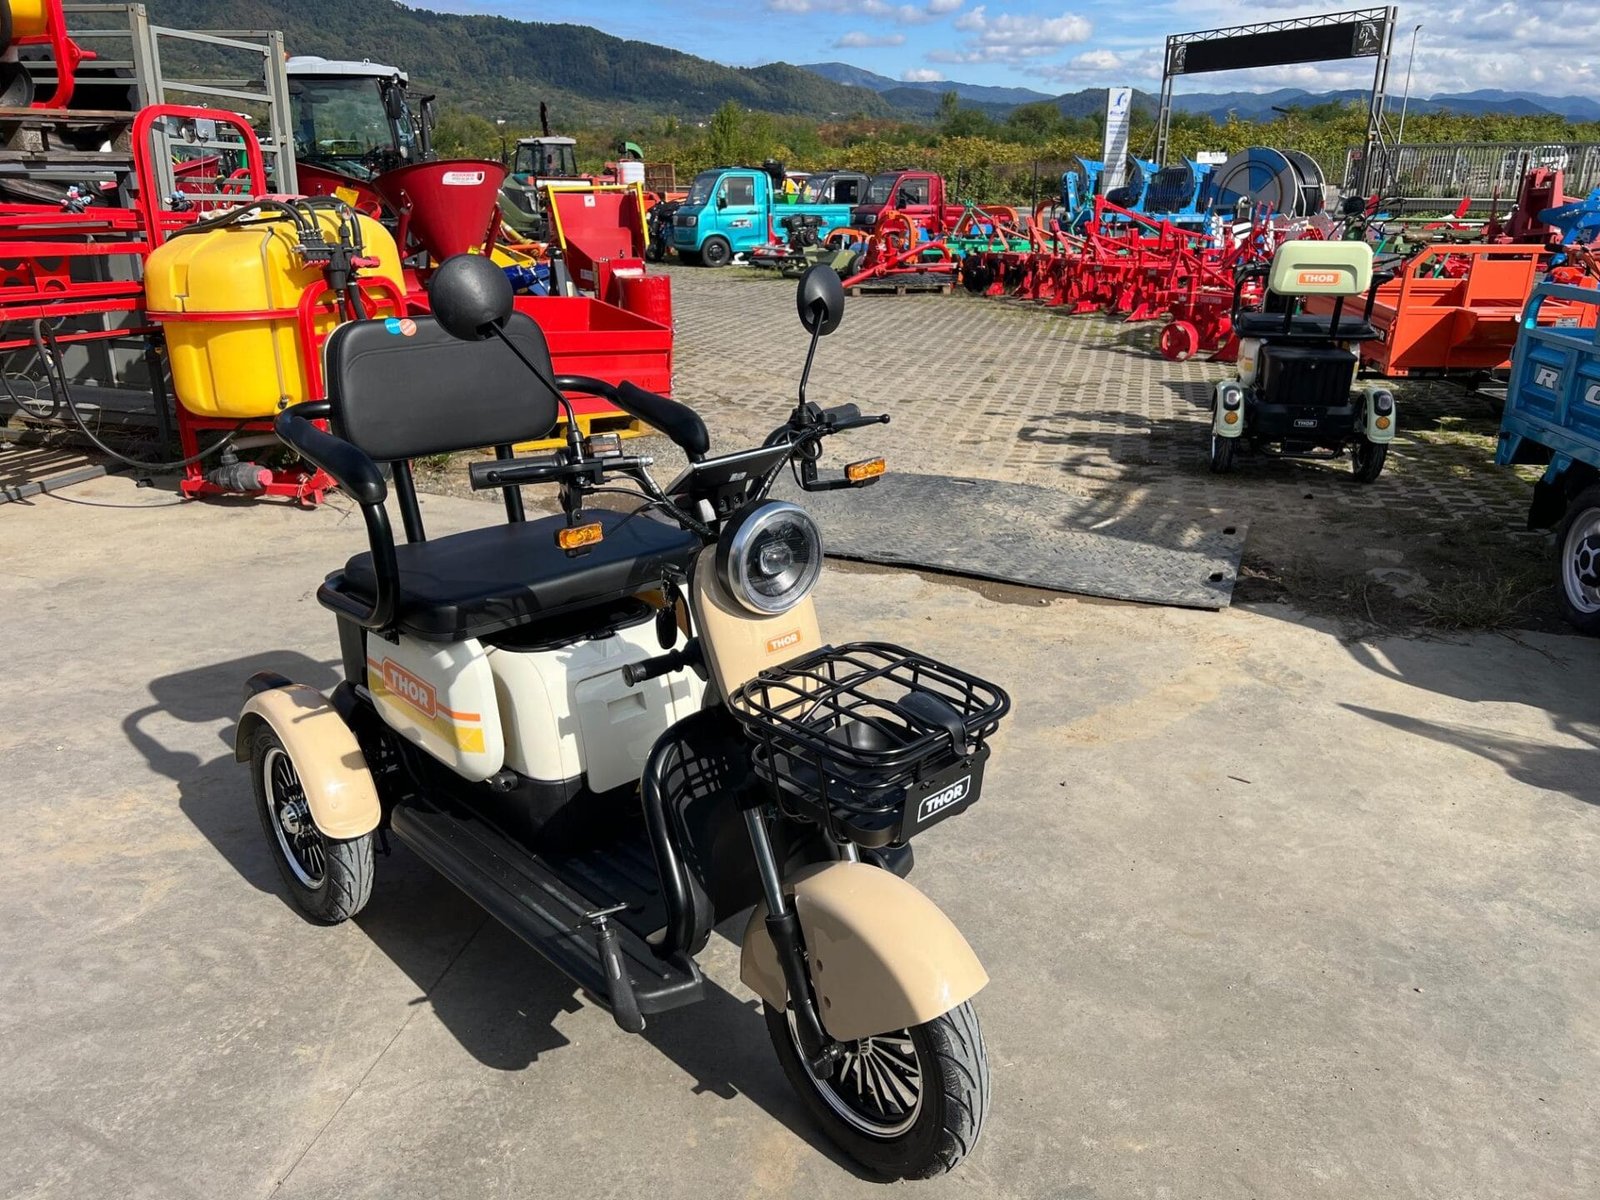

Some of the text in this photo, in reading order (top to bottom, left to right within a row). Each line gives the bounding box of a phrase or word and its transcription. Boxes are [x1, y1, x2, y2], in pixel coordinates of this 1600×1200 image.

[1303, 274, 1335, 283] THOR
[771, 633, 798, 650] THOR
[390, 669, 429, 708] THOR
[925, 784, 964, 813] THOR
